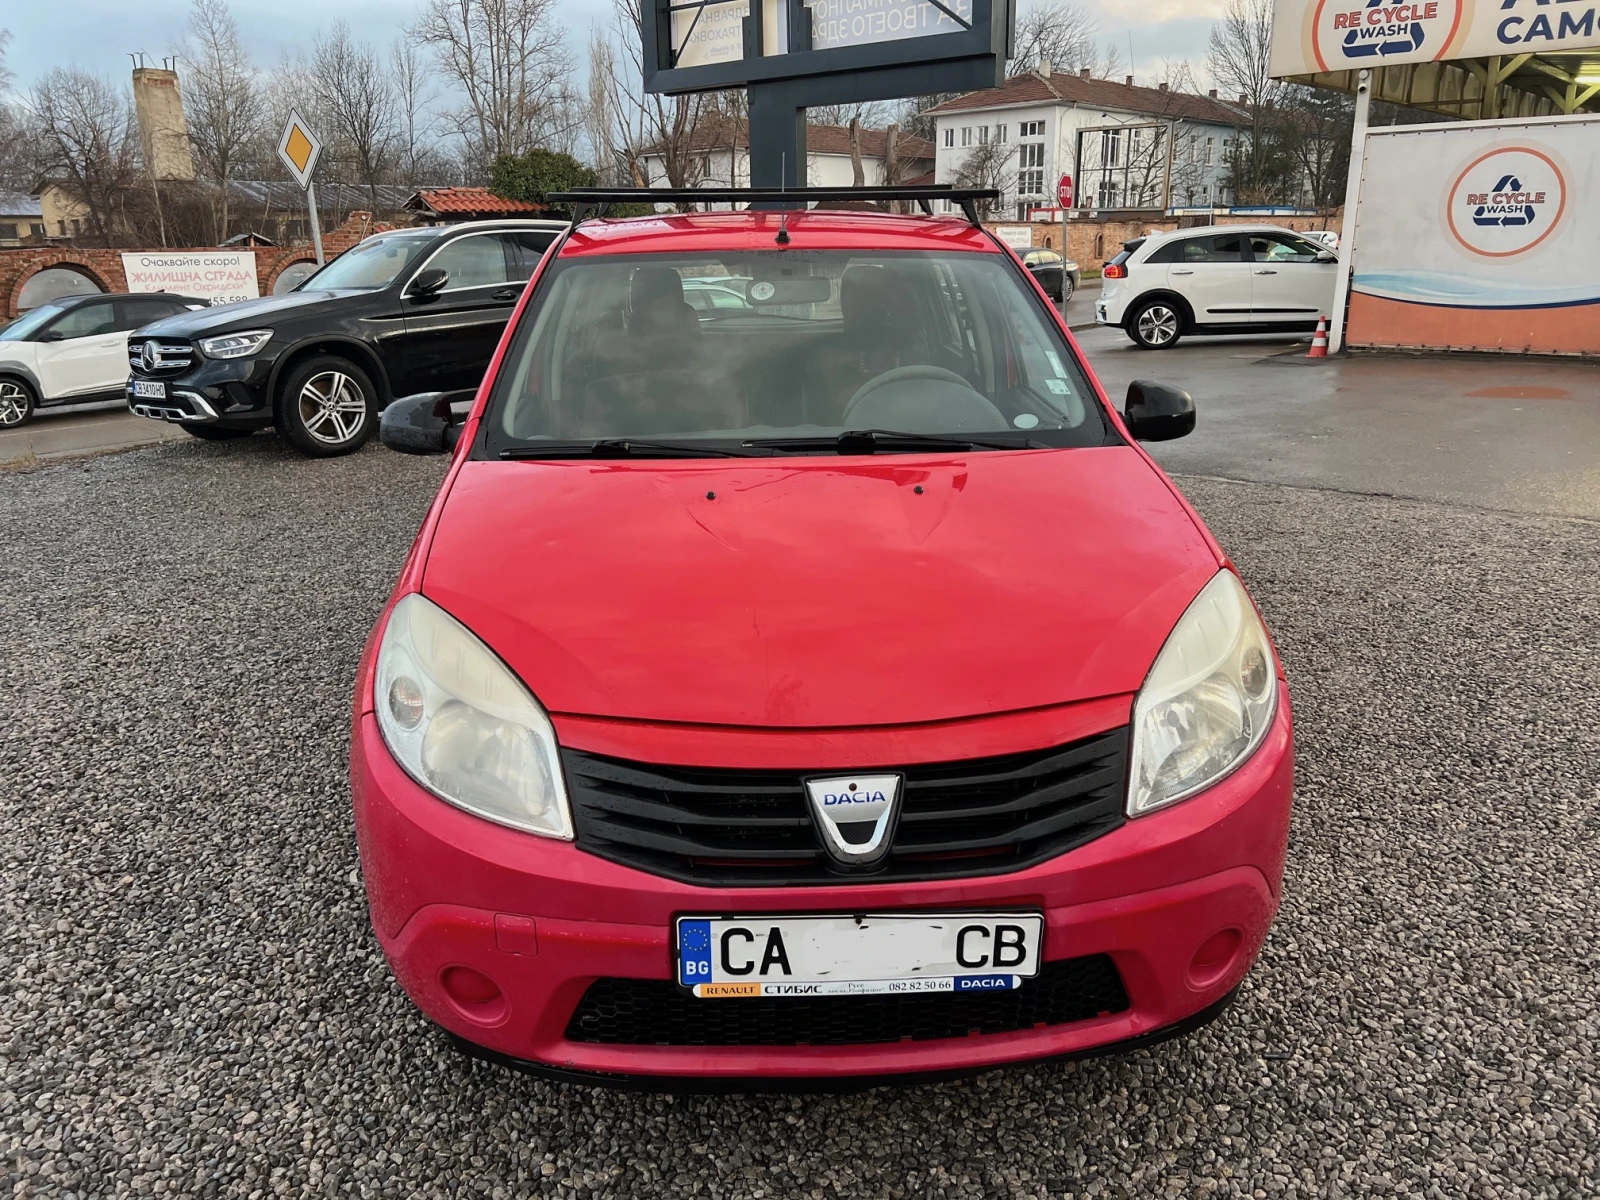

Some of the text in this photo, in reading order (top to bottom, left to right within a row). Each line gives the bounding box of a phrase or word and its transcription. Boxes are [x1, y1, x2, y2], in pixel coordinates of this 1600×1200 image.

[1334, 2, 1438, 29] RE CYCLE
[1359, 24, 1409, 39] WASH
[1497, 8, 1600, 44] САМ
[1467, 192, 1546, 205] RE CYCLE
[1487, 205, 1523, 214] WASH
[141, 256, 240, 268] Очаквайте скоро!
[132, 270, 252, 283] ЖИЛИЩНА СГРАДА
[824, 791, 886, 805] DACIA
[956, 924, 1027, 968] CB
[686, 961, 709, 975] BG
[764, 984, 823, 994] СТИБИС
[889, 983, 907, 991] 082
[909, 982, 921, 991] 82
[924, 981, 936, 990] 50
[938, 981, 951, 989] 66
[961, 979, 1006, 988] DACIA
[706, 986, 756, 995] RENAULT
